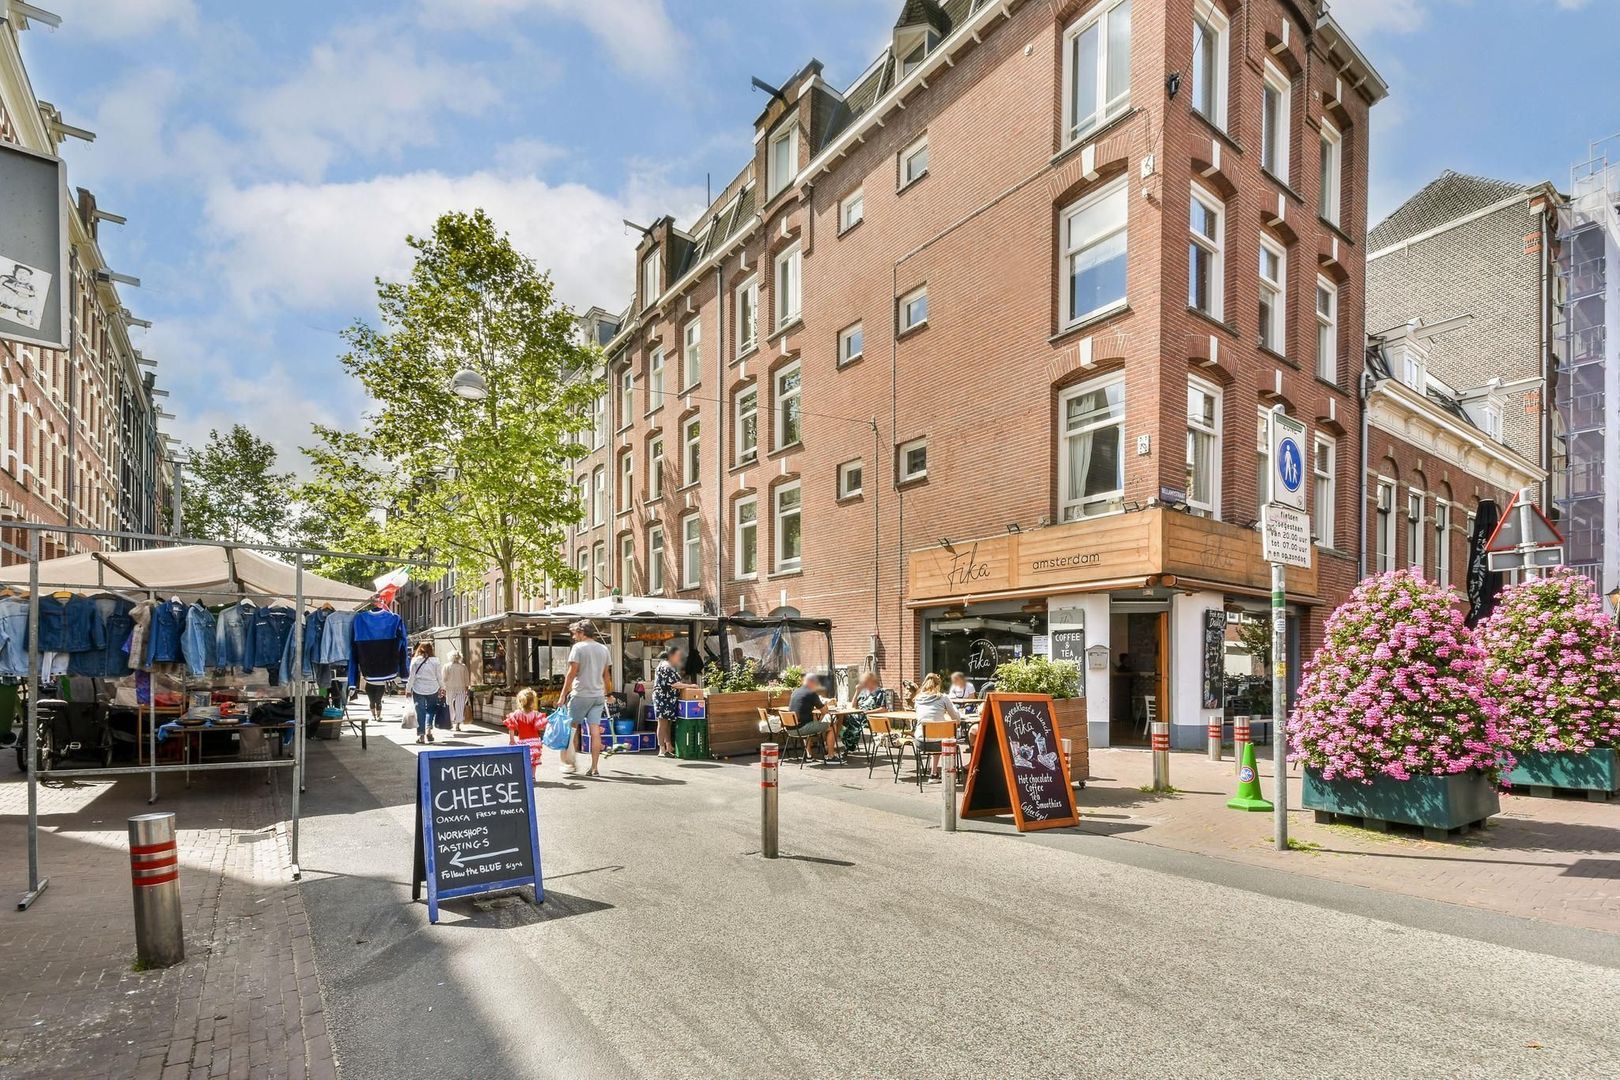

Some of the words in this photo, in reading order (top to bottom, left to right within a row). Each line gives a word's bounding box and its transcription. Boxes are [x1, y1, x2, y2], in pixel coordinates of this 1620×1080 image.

[1282, 532, 1298, 541] 20.00
[1271, 540, 1280, 548] tot
[1282, 542, 1298, 551] 07.00
[947, 542, 991, 592] Fika
[1032, 552, 1100, 570] amsterdam
[1055, 632, 1080, 642] COFFEE
[968, 648, 990, 672] Fika
[1061, 650, 1074, 658] TEA
[1012, 716, 1034, 740] Fika
[1036, 710, 1052, 736] Lunch
[1018, 774, 1028, 784] Hot
[1028, 773, 1053, 784] chocolate
[1026, 784, 1044, 794] Coffee
[434, 782, 522, 812] CHEESE
[1029, 792, 1041, 801] Tea
[1036, 798, 1062, 810] Smoothies
[436, 814, 470, 824] OAXACA
[438, 826, 488, 841] WORKSHOPS
[438, 838, 490, 853] TASTINGS
[441, 870, 465, 880] Follow
[465, 868, 479, 876] the
[479, 862, 502, 873] BLUE
[506, 862, 523, 870] signs
